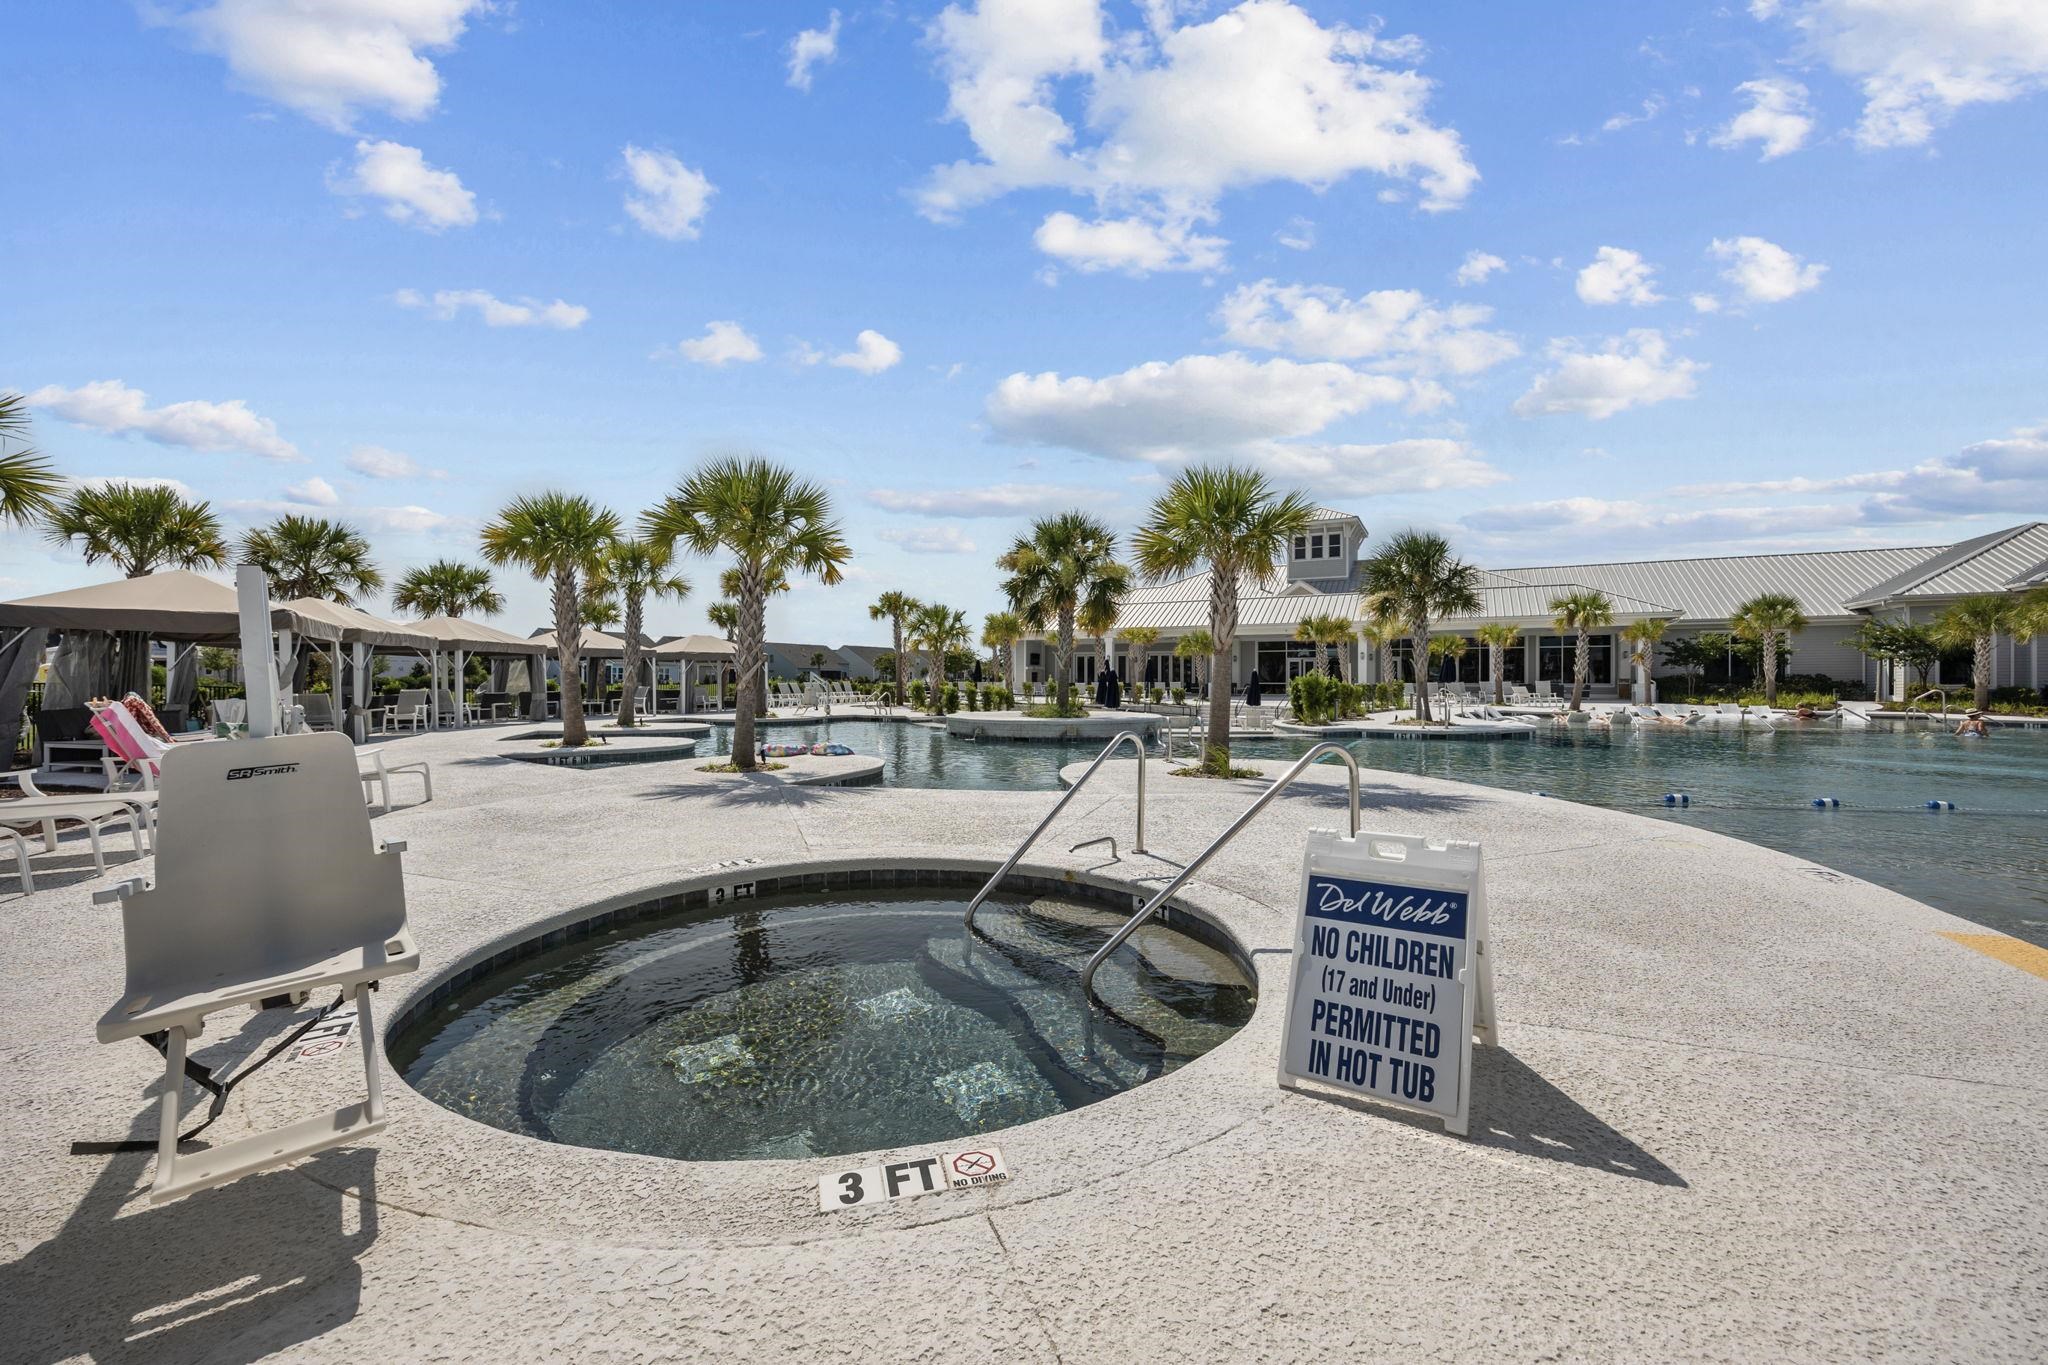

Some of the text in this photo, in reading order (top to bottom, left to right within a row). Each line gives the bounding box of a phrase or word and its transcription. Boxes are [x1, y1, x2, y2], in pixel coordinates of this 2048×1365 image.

[1316, 883, 1372, 912] Del
[1311, 925, 1455, 980] NO CHILDREN
[1322, 965, 1436, 1014] (17 and Under)
[1311, 999, 1441, 1059] PERMITTED
[1308, 1039, 1435, 1103] IN HOT TUB
[838, 1158, 937, 1204] 3 FT
[953, 1172, 1007, 1188] NO DIVING
